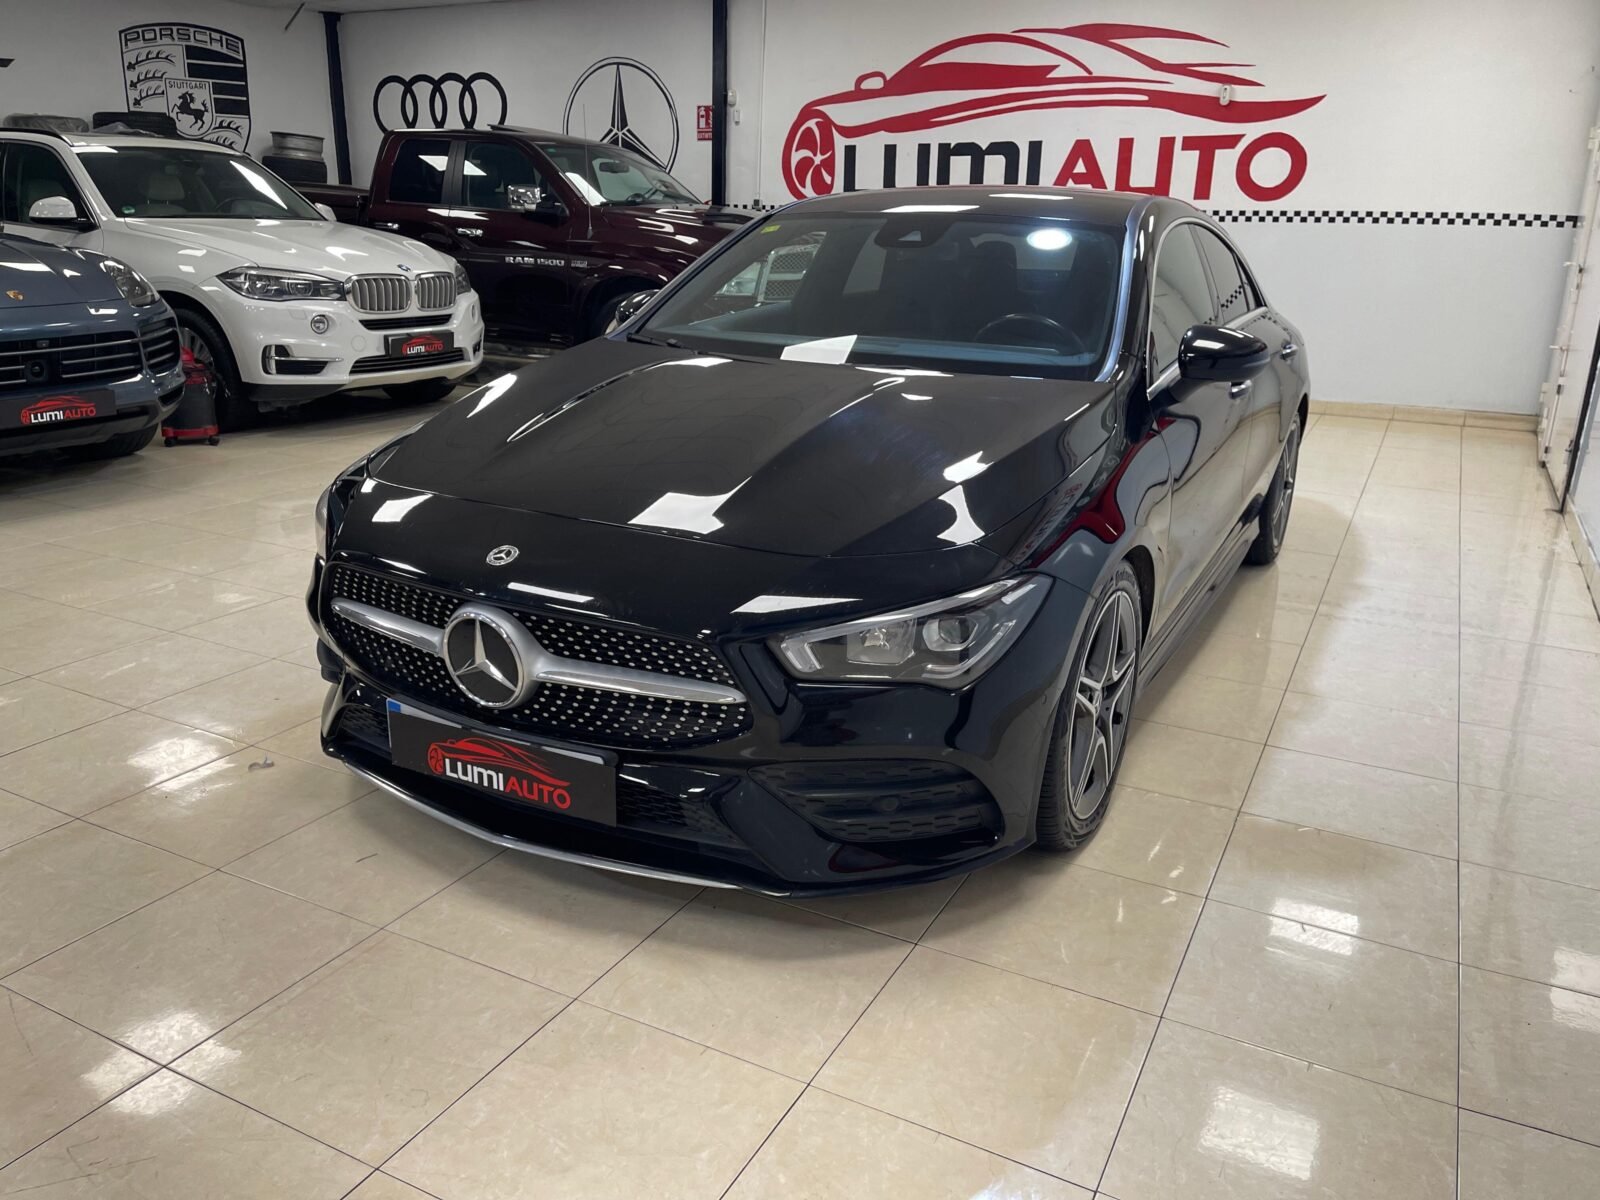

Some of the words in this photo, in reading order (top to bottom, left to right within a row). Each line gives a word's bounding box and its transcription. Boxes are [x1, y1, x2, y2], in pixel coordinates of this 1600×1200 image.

[124, 28, 240, 55] PORSCHE
[168, 80, 207, 90] STUTTGART
[505, 256, 535, 264] RAM
[537, 258, 565, 267] 1500
[407, 343, 443, 354] LUMIAUTO
[30, 407, 96, 423] LUMIAUTO
[444, 758, 571, 809] LUMIAUTO
